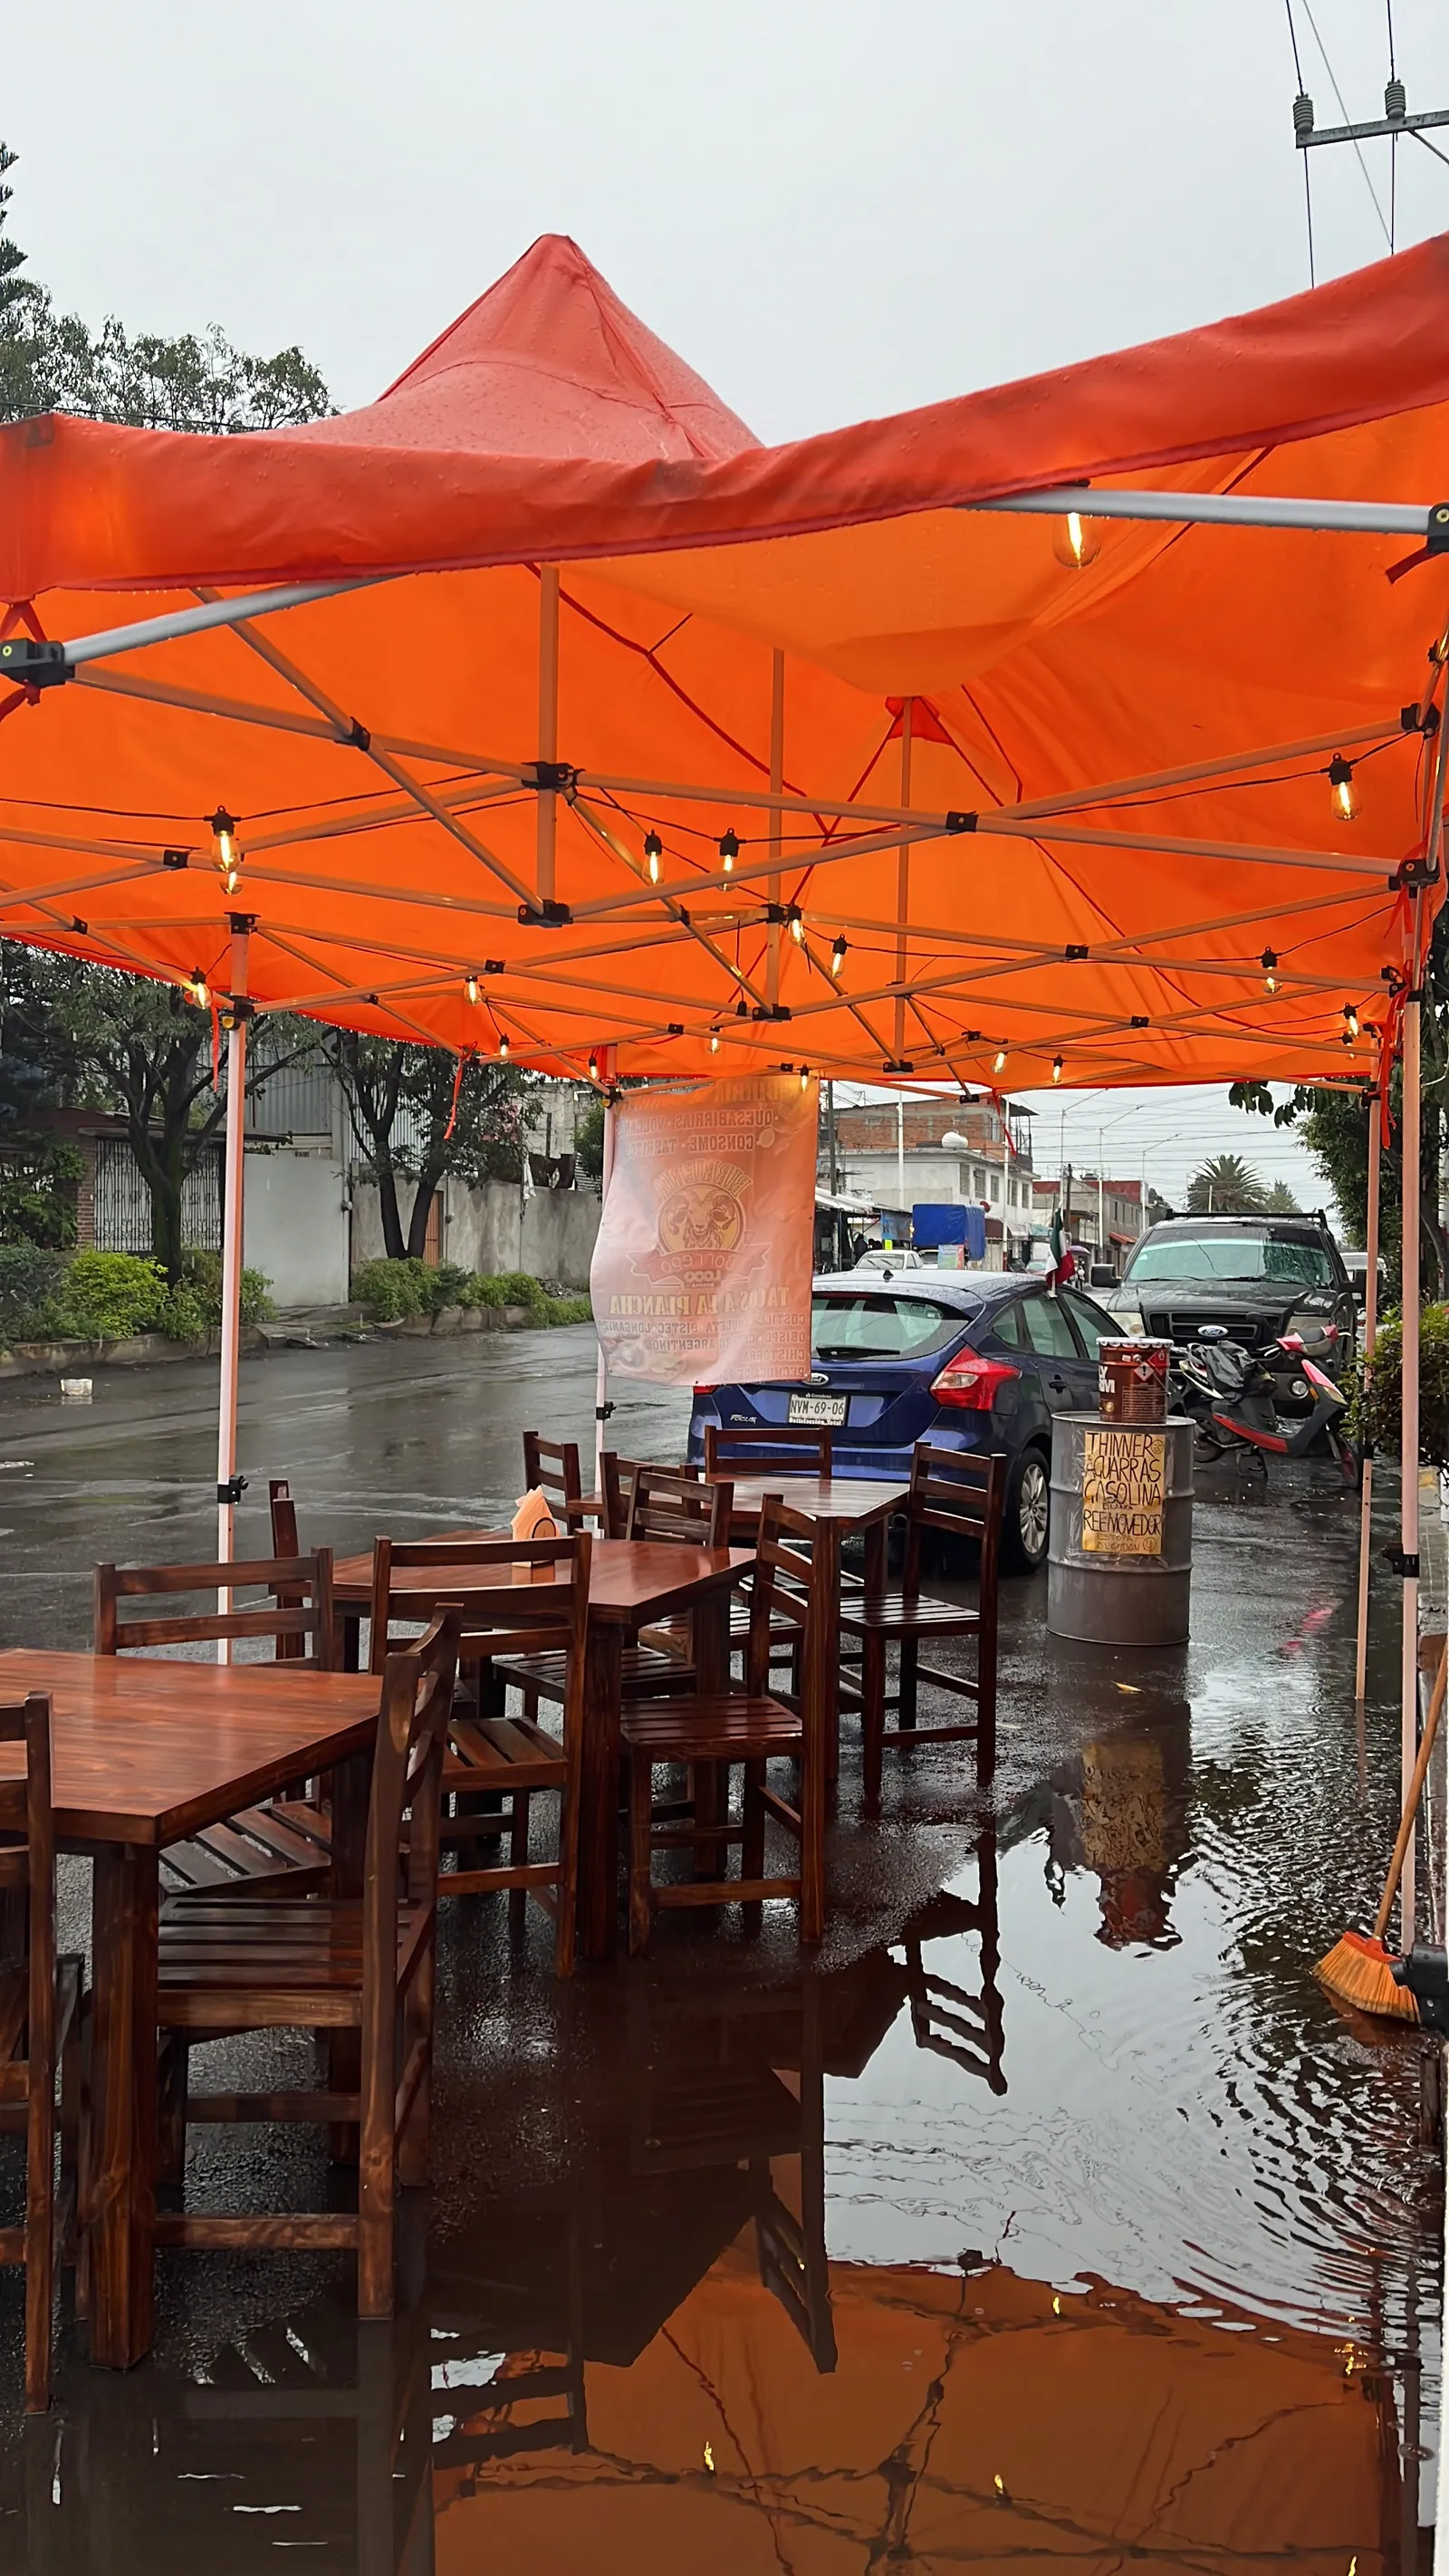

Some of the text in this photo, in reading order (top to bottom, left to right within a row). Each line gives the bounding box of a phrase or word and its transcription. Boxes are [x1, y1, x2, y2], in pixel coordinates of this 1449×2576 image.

[790, 1399, 844, 1415] NVM-69-06
[1087, 1433, 1156, 1459] THINNER
[1085, 1456, 1161, 1483] AGUARRAS
[1085, 1479, 1161, 1506] GASOLINA
[1083, 1509, 1161, 1536] REEMOVEDOR
